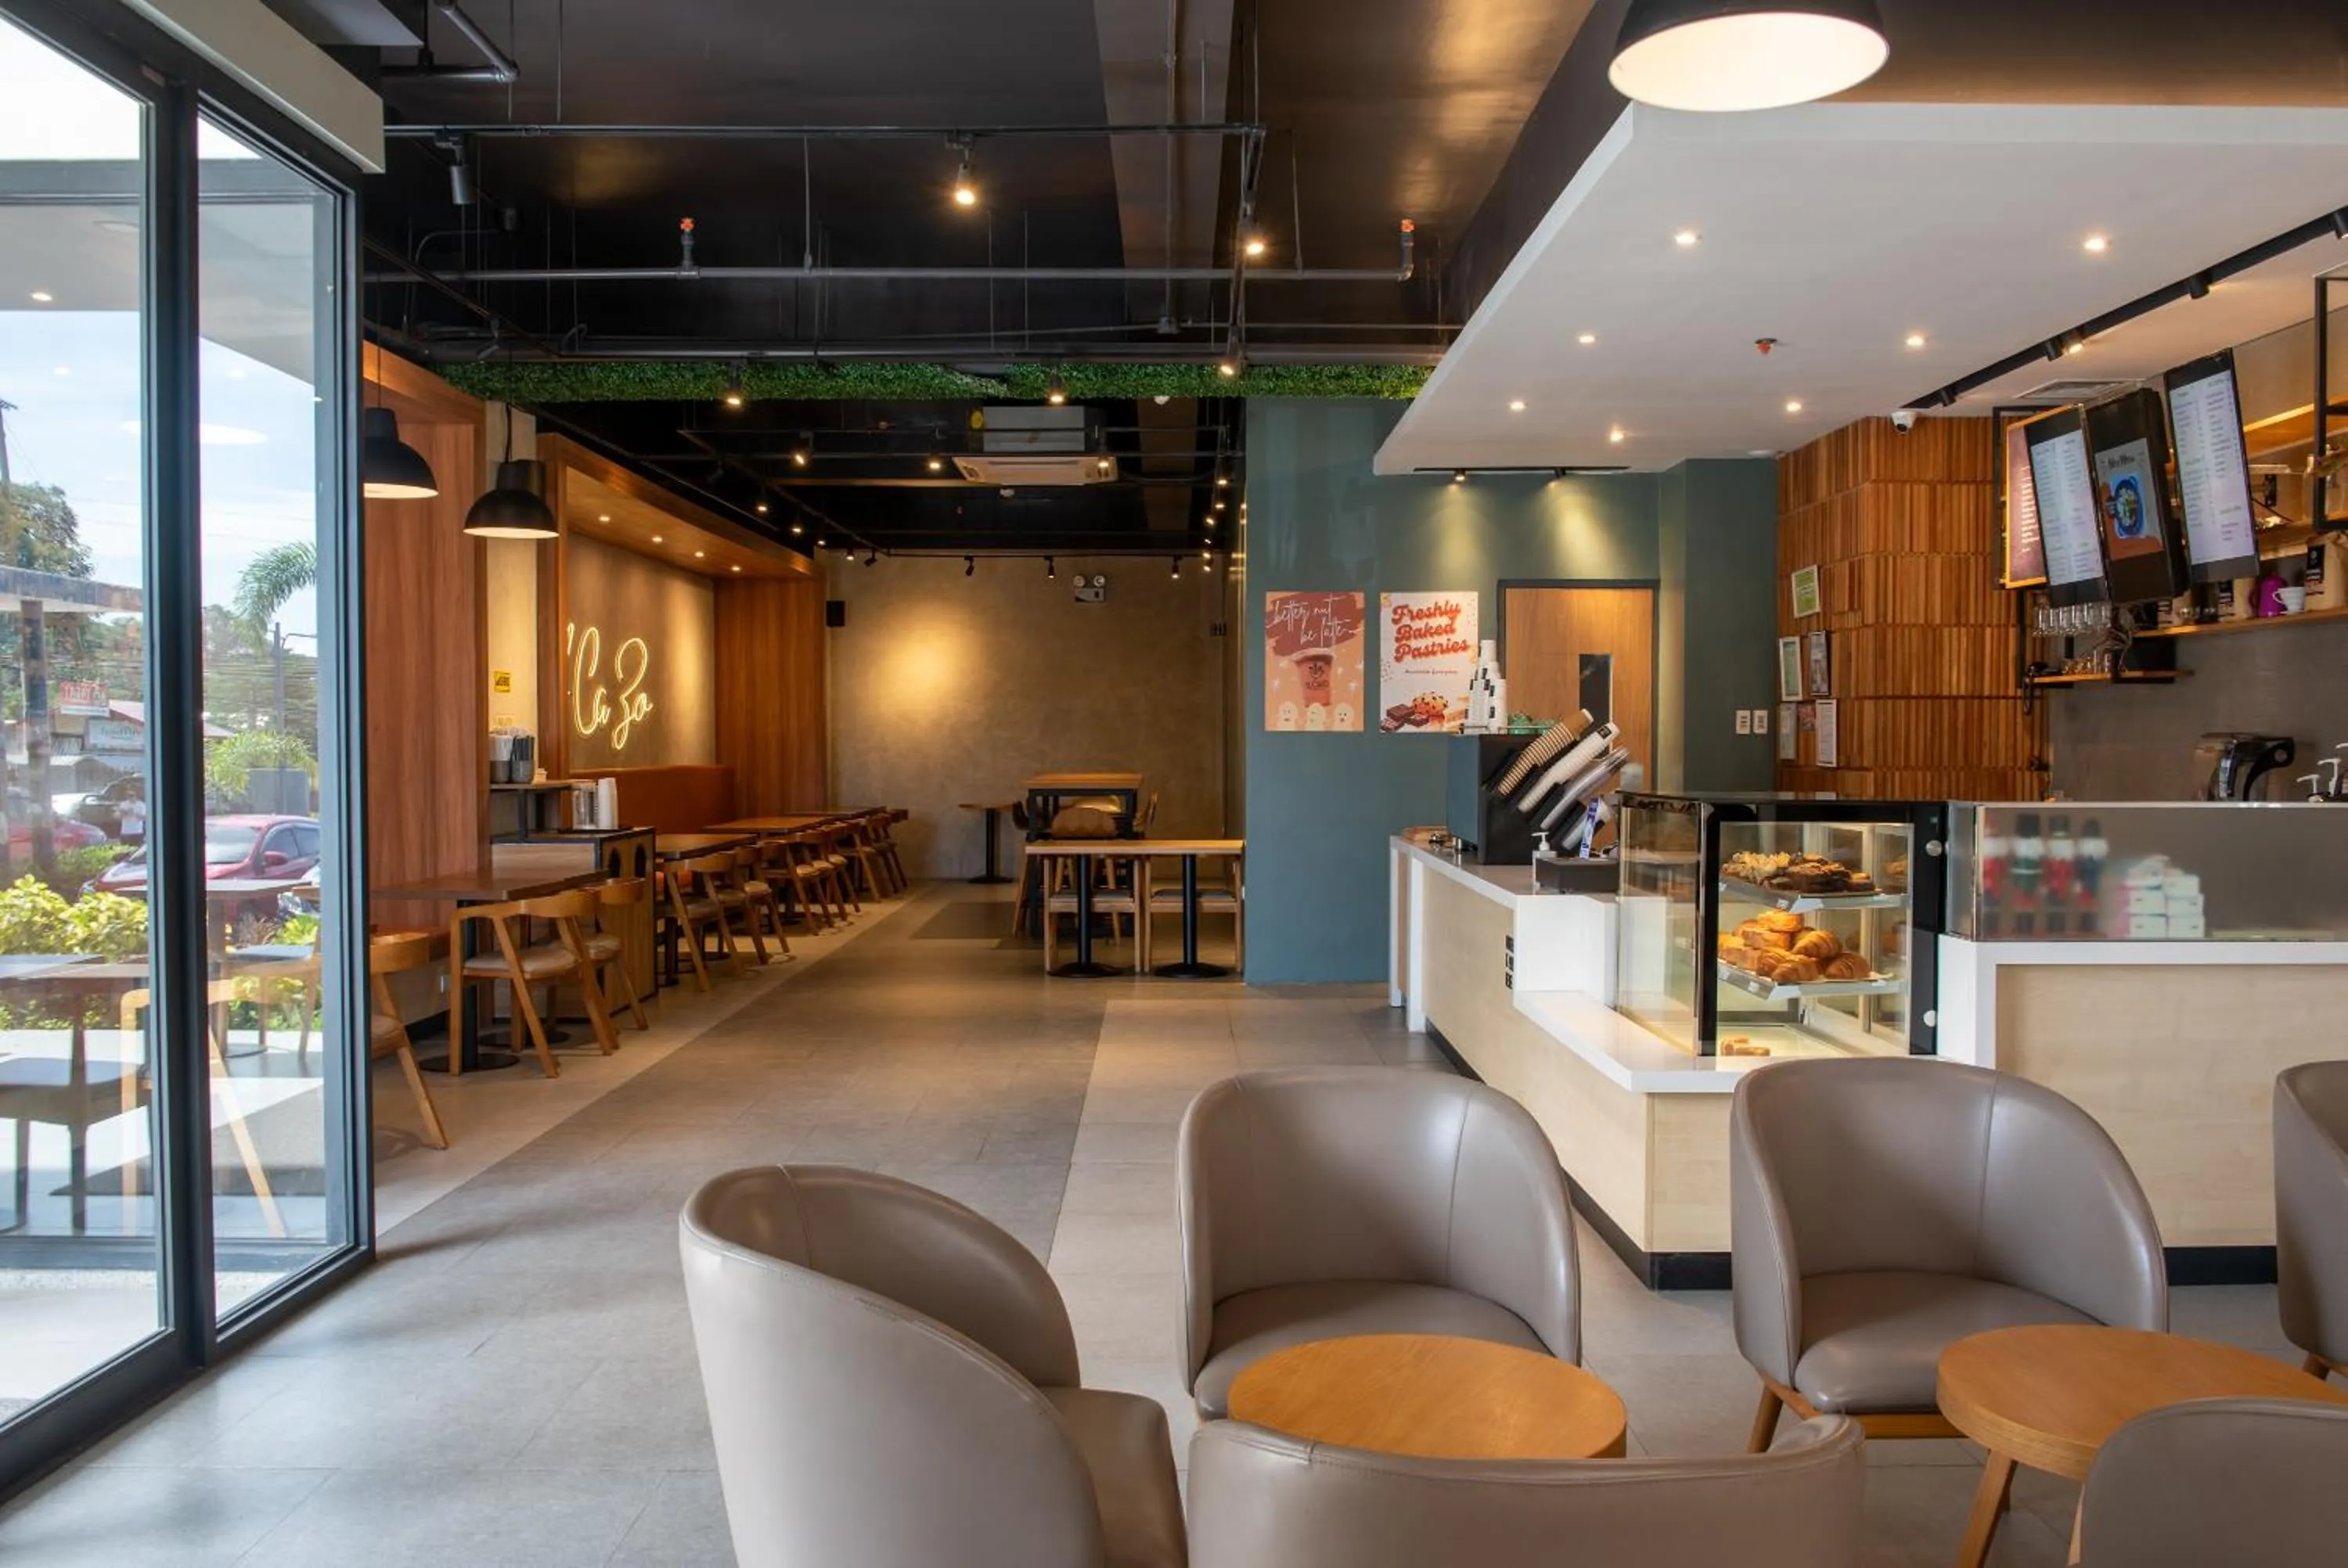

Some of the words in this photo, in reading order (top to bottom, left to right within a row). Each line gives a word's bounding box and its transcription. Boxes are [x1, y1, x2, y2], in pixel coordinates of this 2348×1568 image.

[1392, 600, 1462, 625] Freshly
[1395, 621, 1456, 643] Baked
[1394, 638, 1470, 663] Pastries
